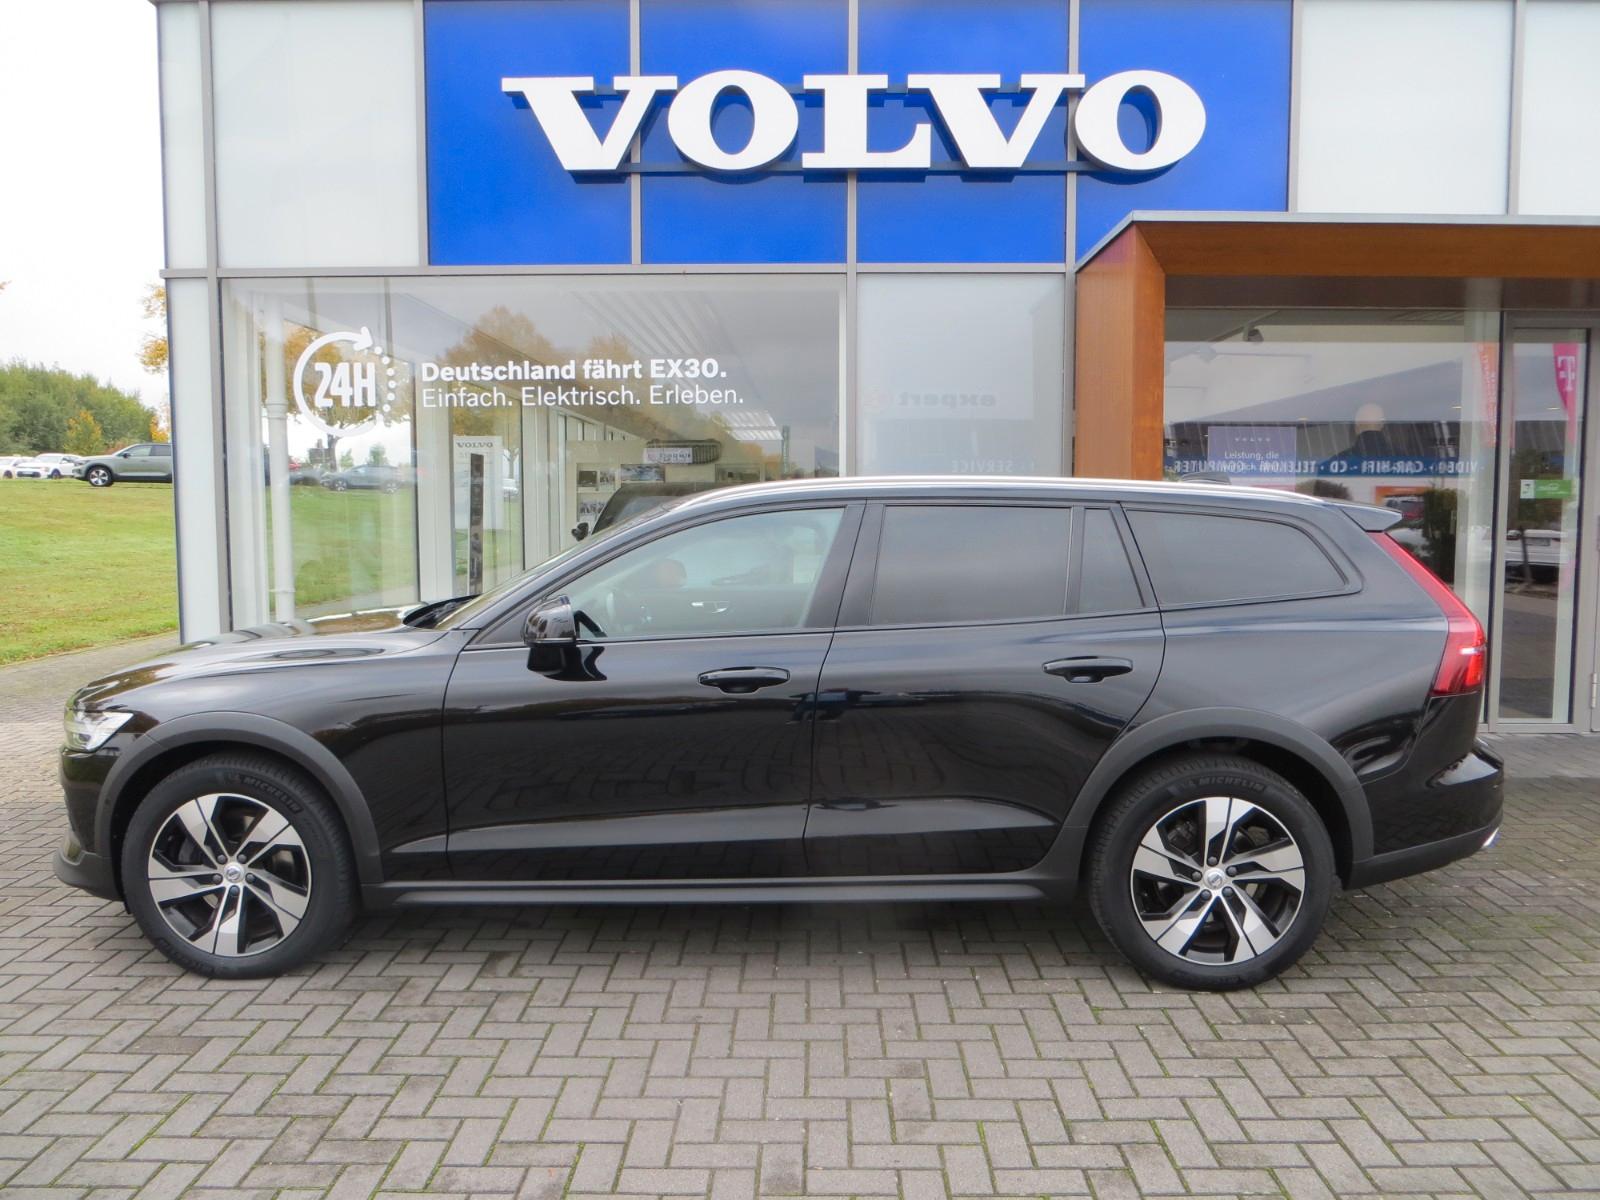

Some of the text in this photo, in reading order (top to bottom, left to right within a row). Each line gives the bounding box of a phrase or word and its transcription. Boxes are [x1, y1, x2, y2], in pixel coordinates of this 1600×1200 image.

[502, 69, 1206, 170] VOLVO
[421, 358, 727, 382] Deutschland fährt EX30.
[314, 362, 376, 408] 24H
[422, 384, 744, 408] Einfach. Elektrisch. Erleben.
[456, 441, 494, 449] VOLVO
[1265, 451, 1279, 460] die
[243, 775, 303, 814] MICHELIN
[1199, 775, 1266, 793] MICHELIN
